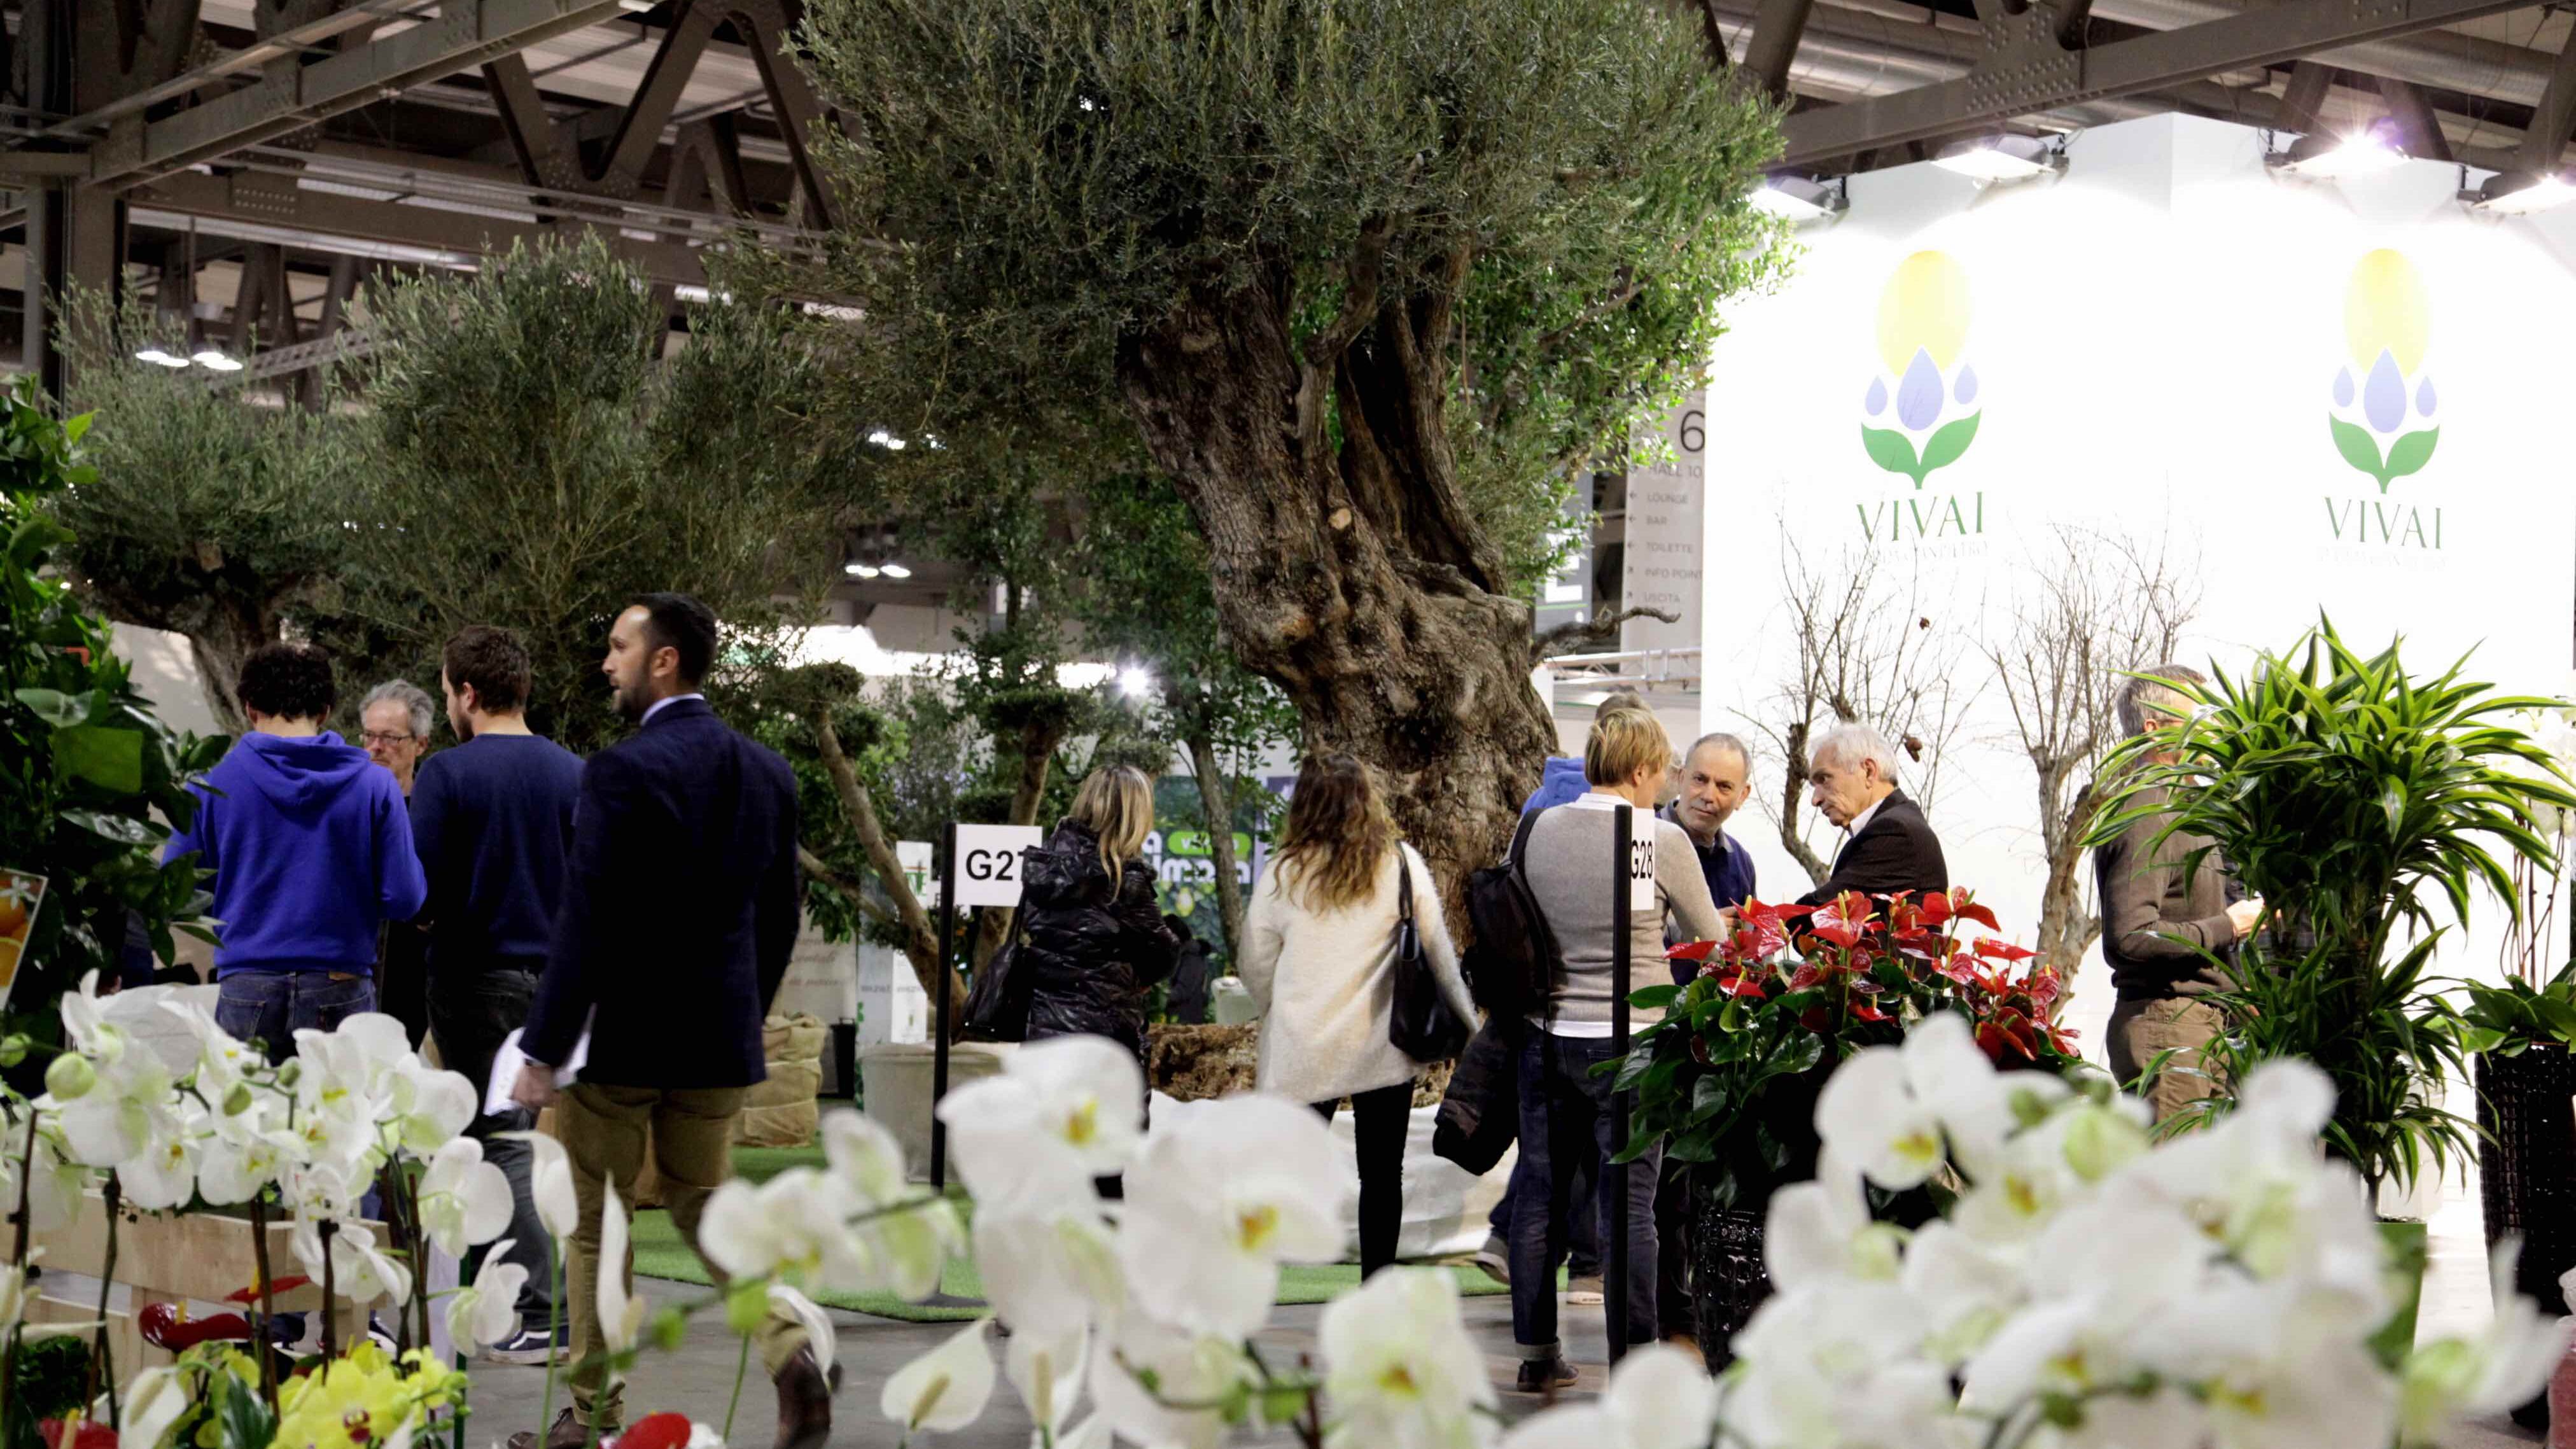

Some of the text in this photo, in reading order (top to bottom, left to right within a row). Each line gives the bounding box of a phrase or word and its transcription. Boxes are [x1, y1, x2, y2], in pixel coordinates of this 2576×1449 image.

[1680, 409, 1705, 452] 6
[1647, 492, 1688, 504] LOUNGE
[1646, 515, 1667, 525] BAR
[1856, 491, 1983, 543] VIVAI
[2324, 496, 2442, 550] VIVAI
[1646, 542, 1693, 553] TOILETTE
[1645, 568, 1669, 578] INFO
[965, 849, 1024, 881] G2
[1631, 839, 1653, 879] G28
